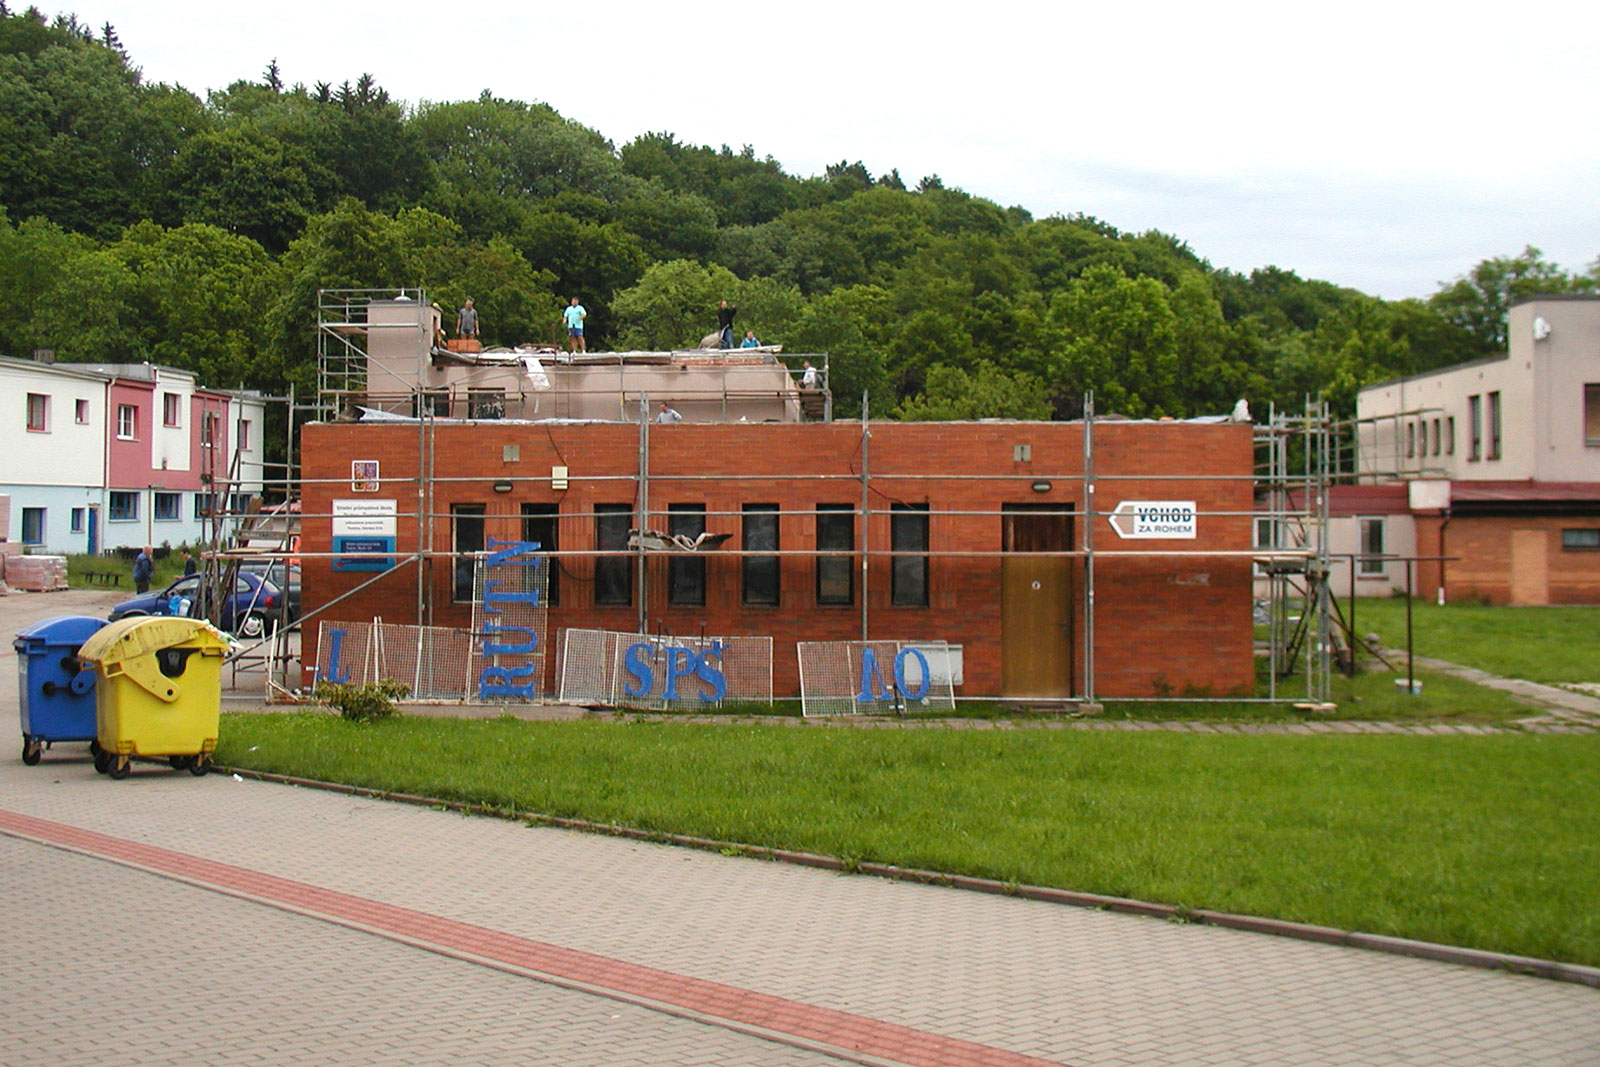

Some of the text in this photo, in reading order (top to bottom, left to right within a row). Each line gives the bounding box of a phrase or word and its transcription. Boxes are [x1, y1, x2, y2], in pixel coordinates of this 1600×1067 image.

[1138, 507, 1192, 523] VCHOD
[1138, 525, 1192, 533] ZA ROHEM
